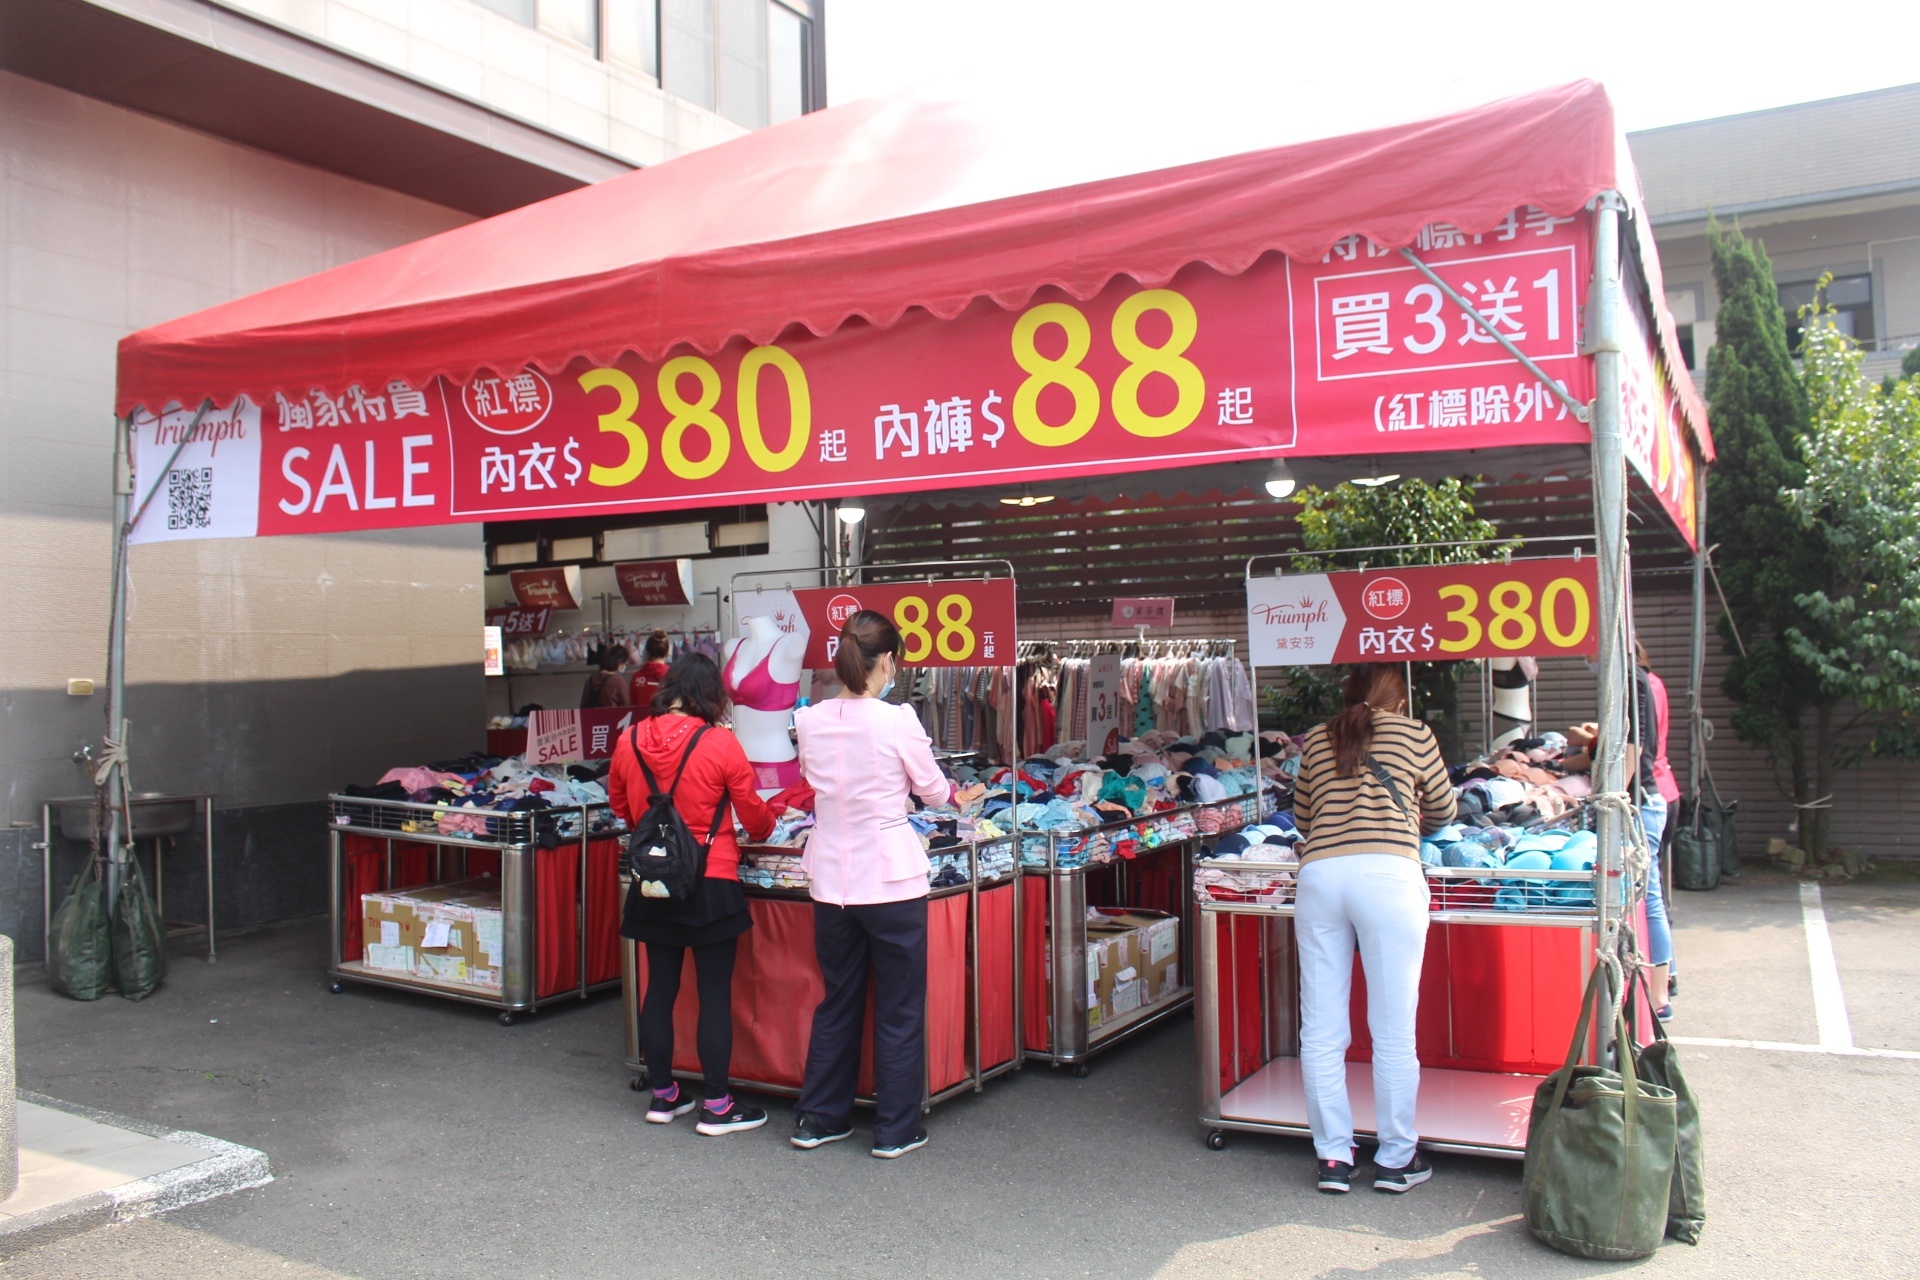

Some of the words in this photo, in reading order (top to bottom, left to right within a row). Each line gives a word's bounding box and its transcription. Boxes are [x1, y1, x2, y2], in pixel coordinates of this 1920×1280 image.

[1331, 268, 1560, 360] 買3送1
[472, 374, 542, 418] 紅標
[577, 344, 812, 487] 380
[819, 429, 848, 463] 起
[1011, 288, 1206, 447] 88
[1217, 387, 1254, 426] 起
[1374, 379, 1569, 432] (紅標除外)
[278, 434, 436, 516] SALE
[624, 572, 668, 591] Triumph
[1368, 589, 1404, 607] 紅標
[894, 594, 976, 662] 88
[1251, 599, 1328, 631] Triumph
[1438, 577, 1591, 652] 380
[539, 734, 578, 763] SALE
